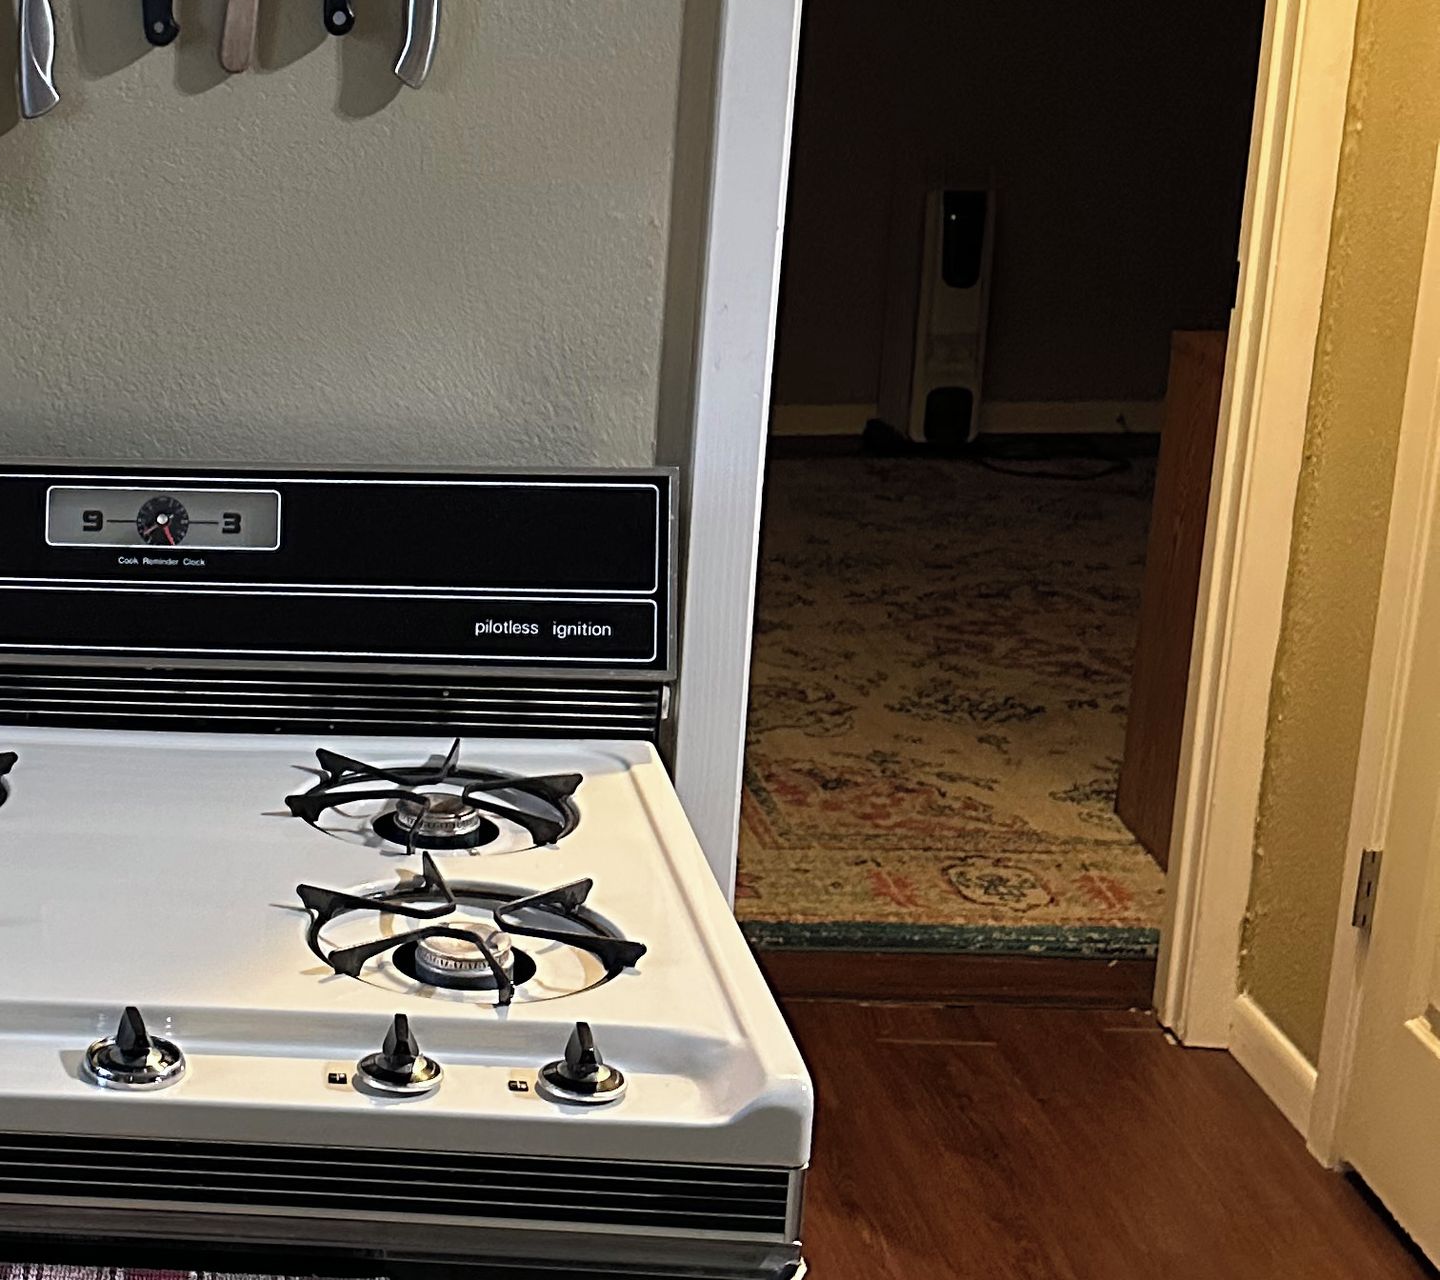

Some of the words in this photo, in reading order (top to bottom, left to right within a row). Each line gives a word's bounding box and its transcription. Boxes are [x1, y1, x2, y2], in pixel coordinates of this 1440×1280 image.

[82, 510, 104, 532] 9
[221, 512, 242, 534] 3
[118, 556, 139, 565] Cook
[142, 557, 179, 566] Reminder
[183, 558, 205, 566] Clock
[475, 619, 539, 636] pilotless
[552, 621, 612, 639] ignition
